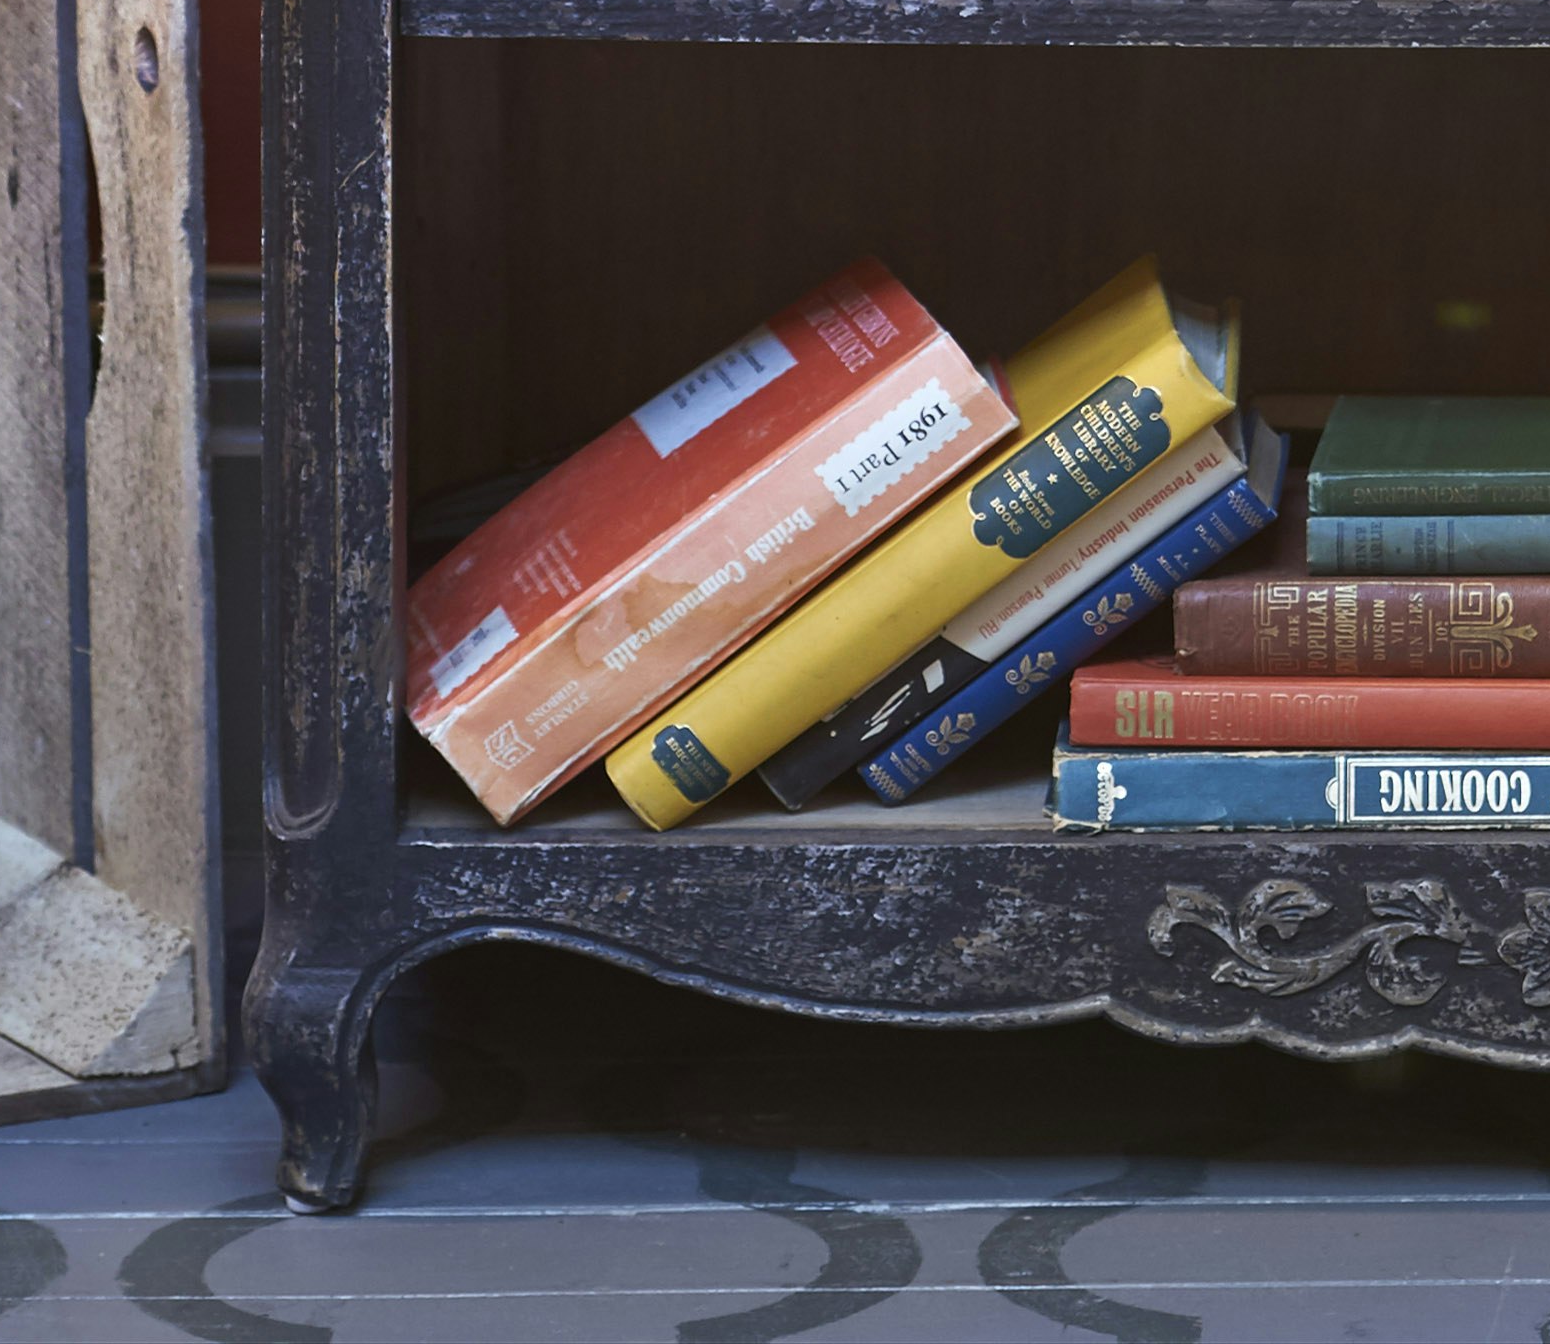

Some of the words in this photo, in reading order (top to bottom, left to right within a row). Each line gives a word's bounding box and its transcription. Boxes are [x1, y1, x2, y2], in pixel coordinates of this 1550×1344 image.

[897, 400, 949, 446] 1981
[1079, 404, 1137, 473] CHILDREN'S
[1095, 398, 1142, 454] MODERN
[1117, 401, 1142, 431] THE
[850, 441, 901, 485] Part
[1044, 431, 1102, 501] KNOWLEDGE
[1072, 419, 1117, 474] LIBRARY
[1073, 447, 1091, 464] OF
[1192, 451, 1223, 475] The
[1002, 468, 1021, 493] THE
[1017, 491, 1052, 530] WORLD
[1016, 469, 1038, 493] Book
[1129, 472, 1198, 525] Persuasion
[988, 496, 1023, 536] BOOKS
[1008, 498, 1023, 516] OF
[745, 505, 817, 566] British
[1194, 523, 1222, 555] PLAYS
[602, 559, 748, 673] Commonwealth
[1288, 614, 1300, 648] THE
[1307, 588, 1329, 670] POPULAR
[1373, 599, 1386, 661] DIVISION
[524, 678, 580, 726] GIBBONS
[533, 691, 590, 742] STANLEY
[1114, 689, 1175, 740] SLR
[1180, 690, 1262, 741] YEAR
[1269, 692, 1360, 743] BOOK
[1378, 768, 1532, 814] COOKING
